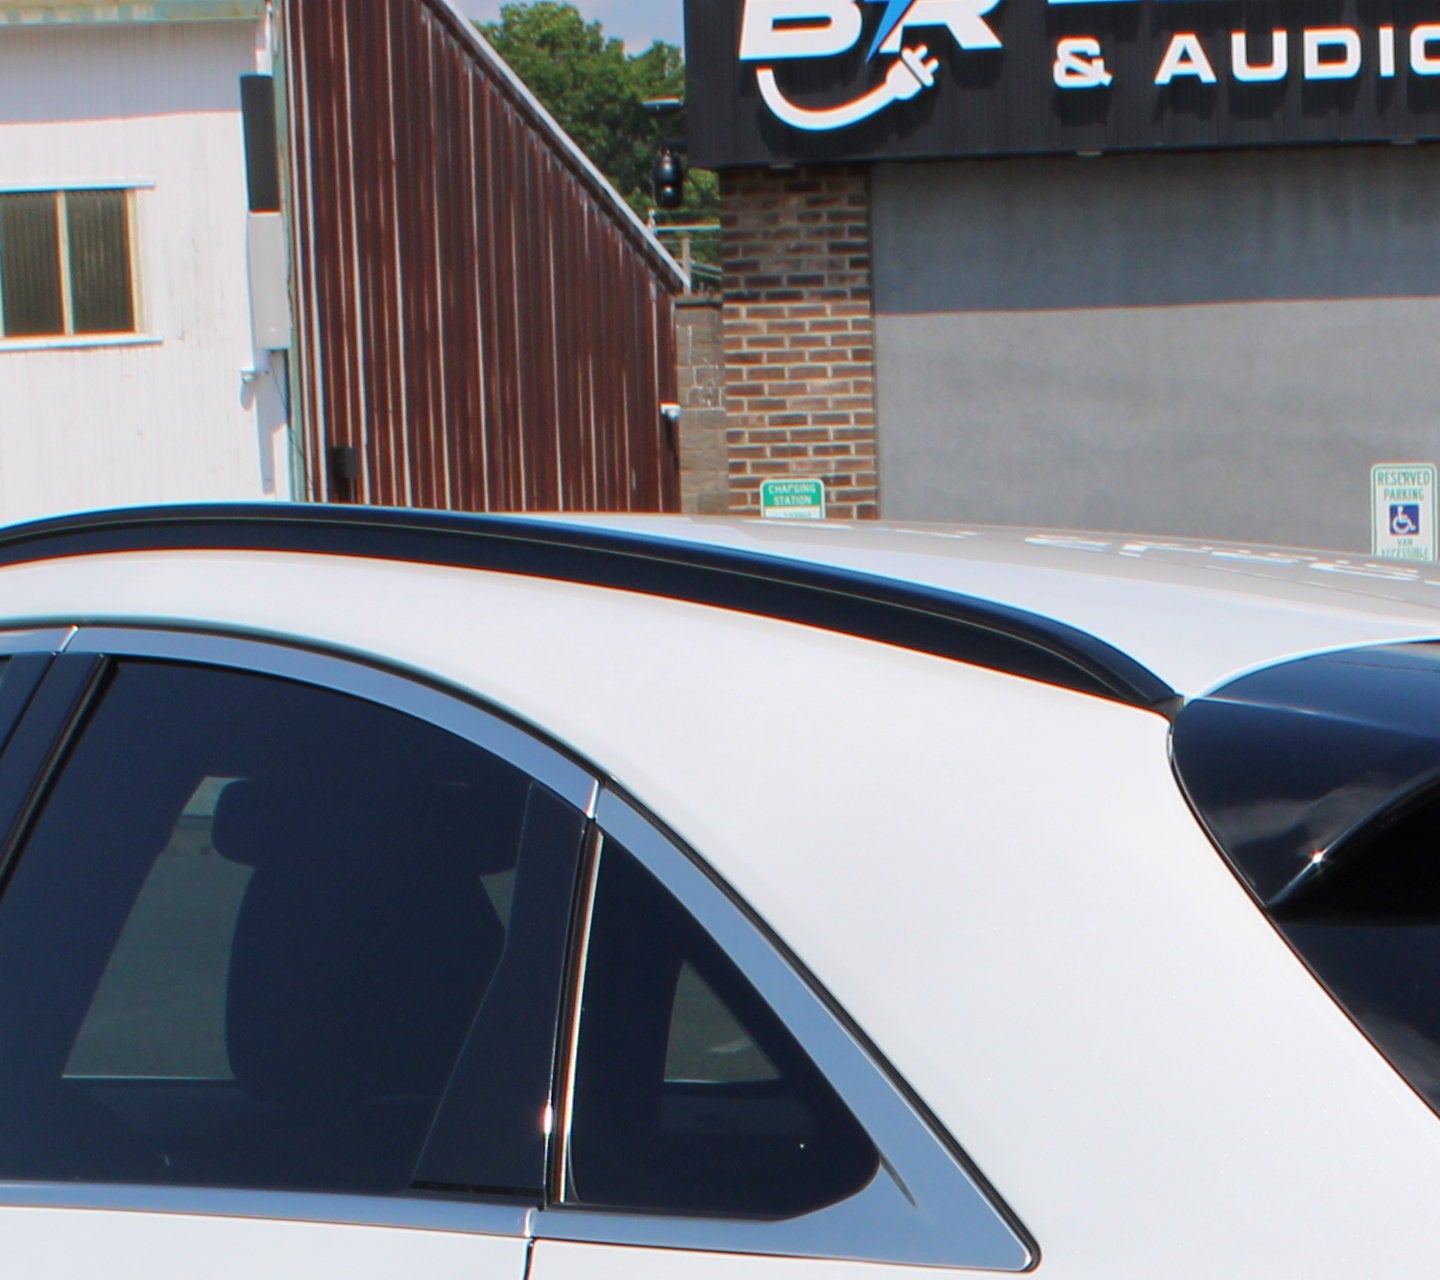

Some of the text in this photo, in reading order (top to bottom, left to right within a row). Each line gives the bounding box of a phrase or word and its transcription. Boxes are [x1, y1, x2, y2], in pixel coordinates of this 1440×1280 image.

[1053, 36, 1112, 88] &
[1377, 470, 1431, 486] RESERVED
[768, 483, 817, 495] CHARGING
[1383, 487, 1425, 501] PARKING
[773, 494, 812, 506] STATION
